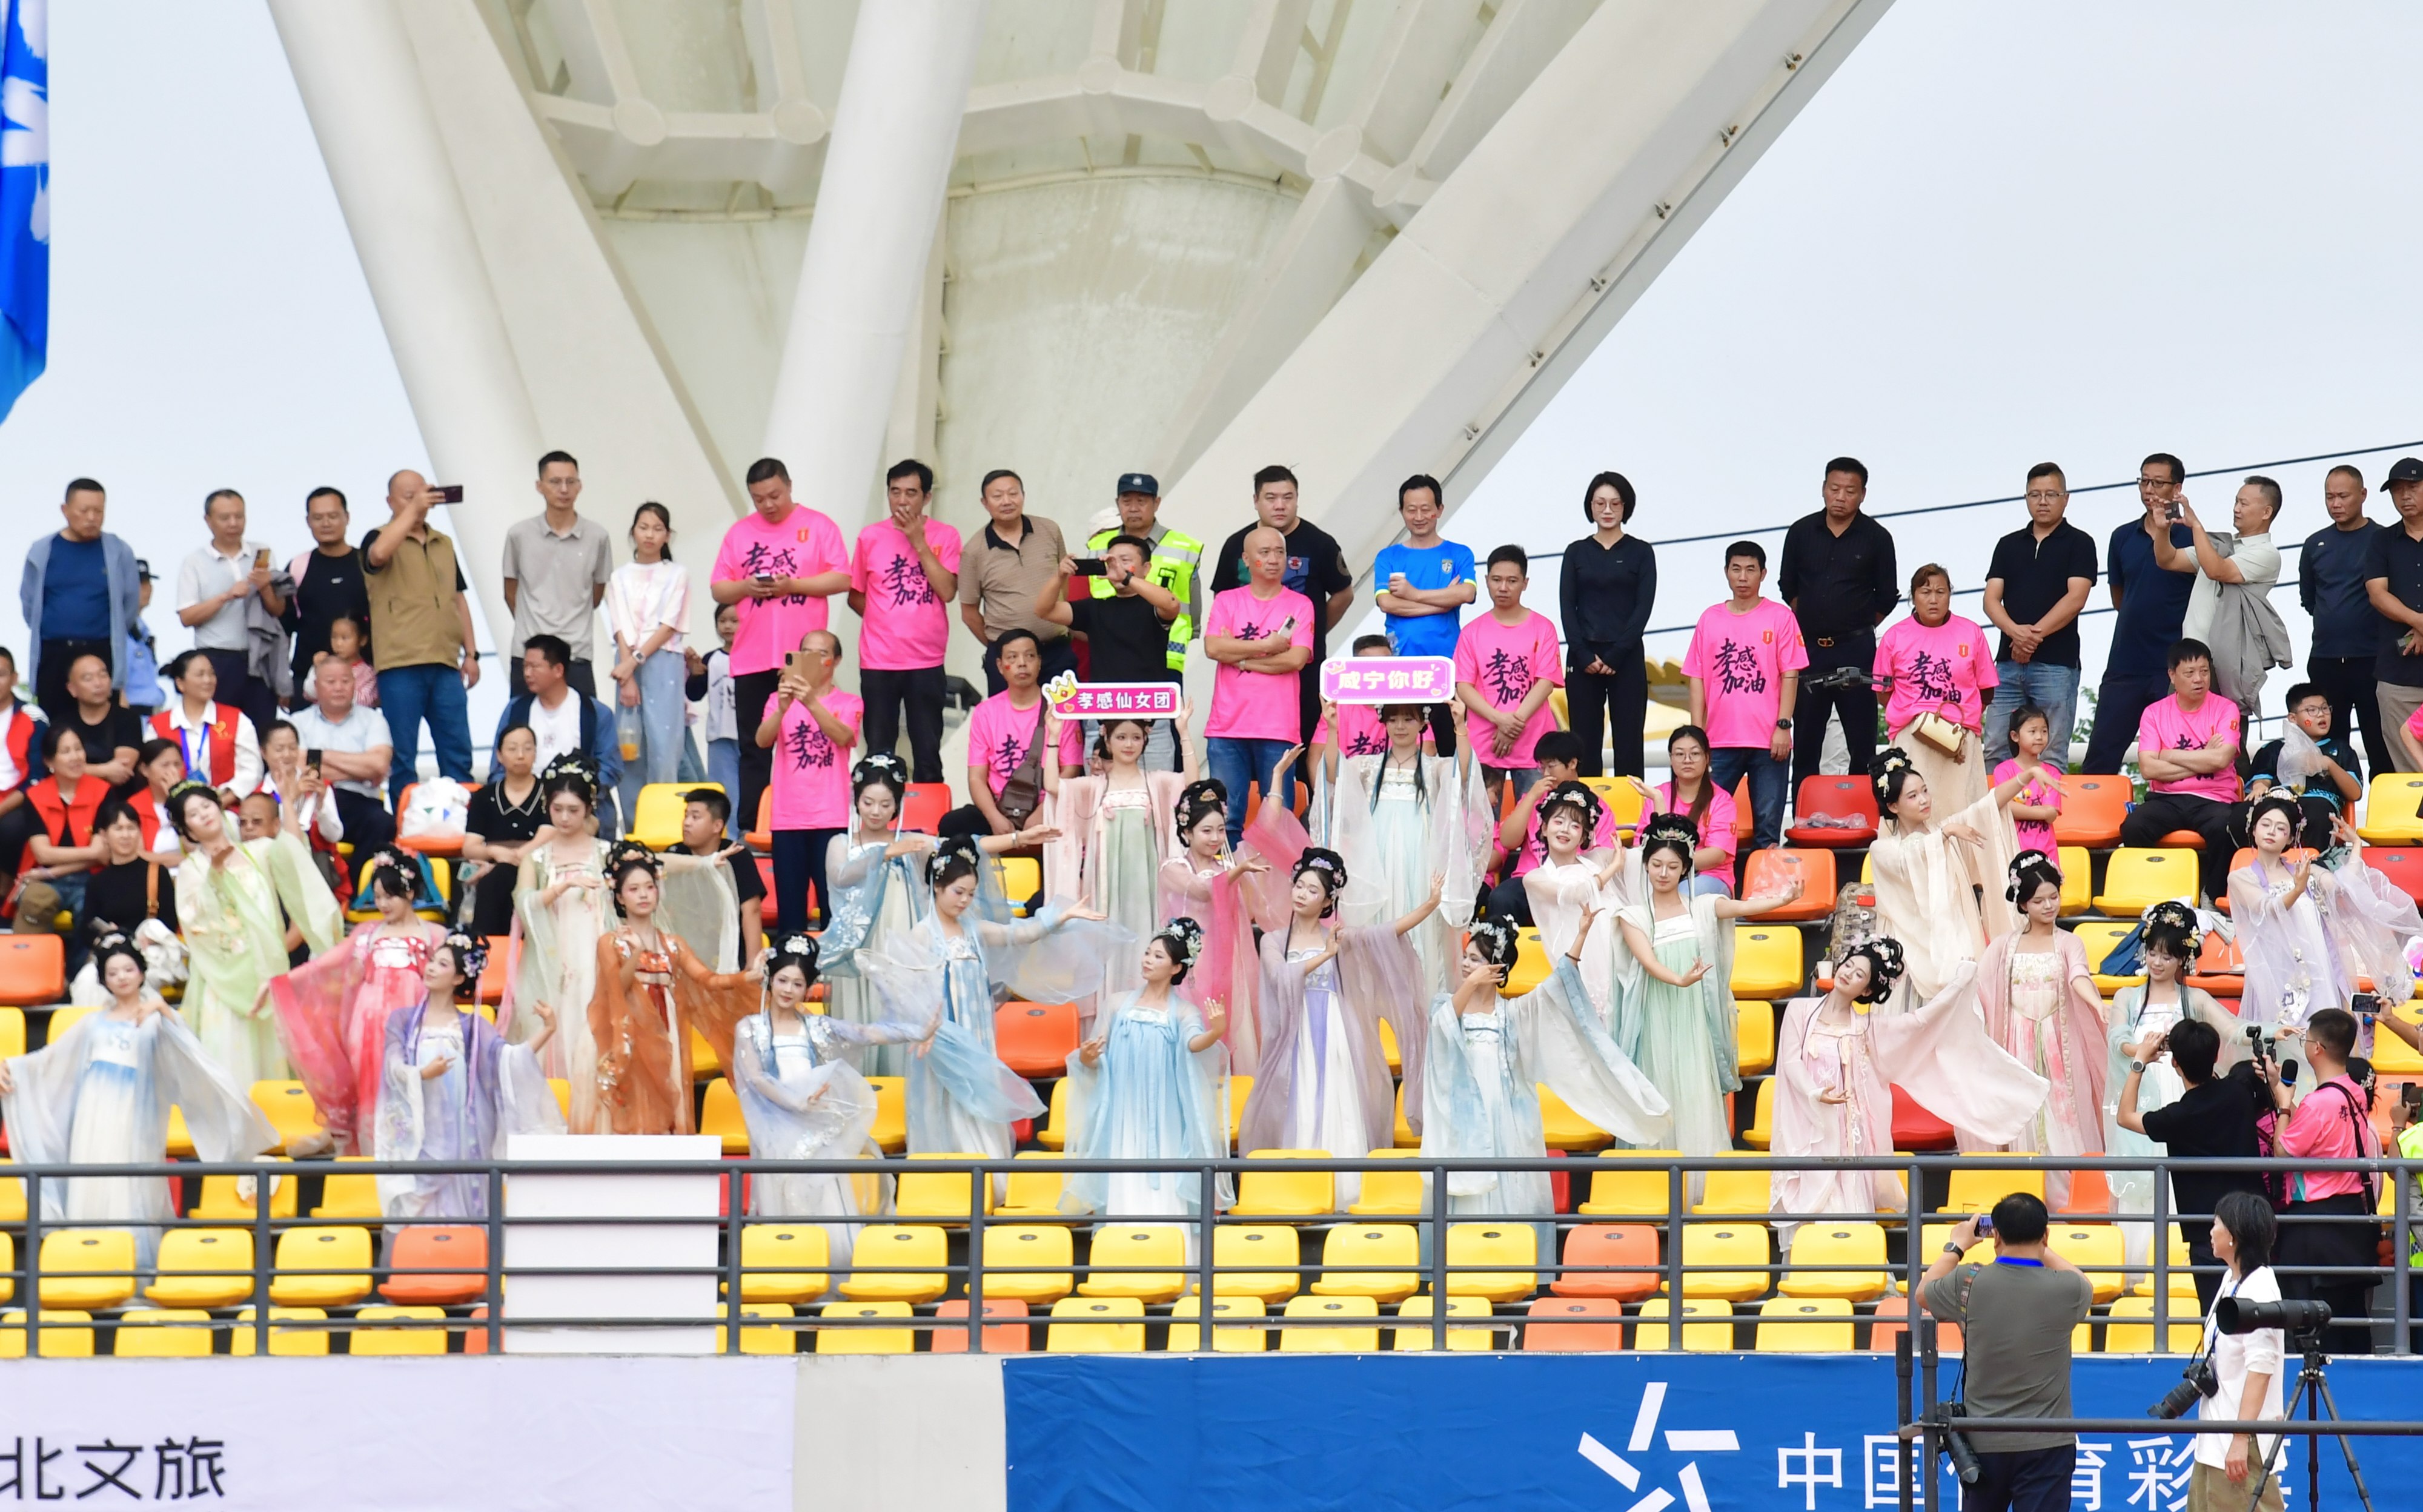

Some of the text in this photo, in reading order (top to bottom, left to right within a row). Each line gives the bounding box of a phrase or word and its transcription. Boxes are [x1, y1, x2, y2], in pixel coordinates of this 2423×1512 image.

[890, 581, 933, 611] 加油
[1483, 648, 1530, 686] 孝感
[1713, 637, 1757, 677] 孝感
[1908, 651, 1952, 685] 孝感
[1338, 670, 1434, 690] 咸宁你好
[1719, 670, 1766, 700] 加油
[1914, 681, 1961, 704] 加油
[1077, 691, 1171, 709] 孝感仙女团
[793, 746, 834, 774] 加油
[0, 1436, 225, 1500] 北文旅
[1778, 1431, 2292, 1512] 中国育彩
